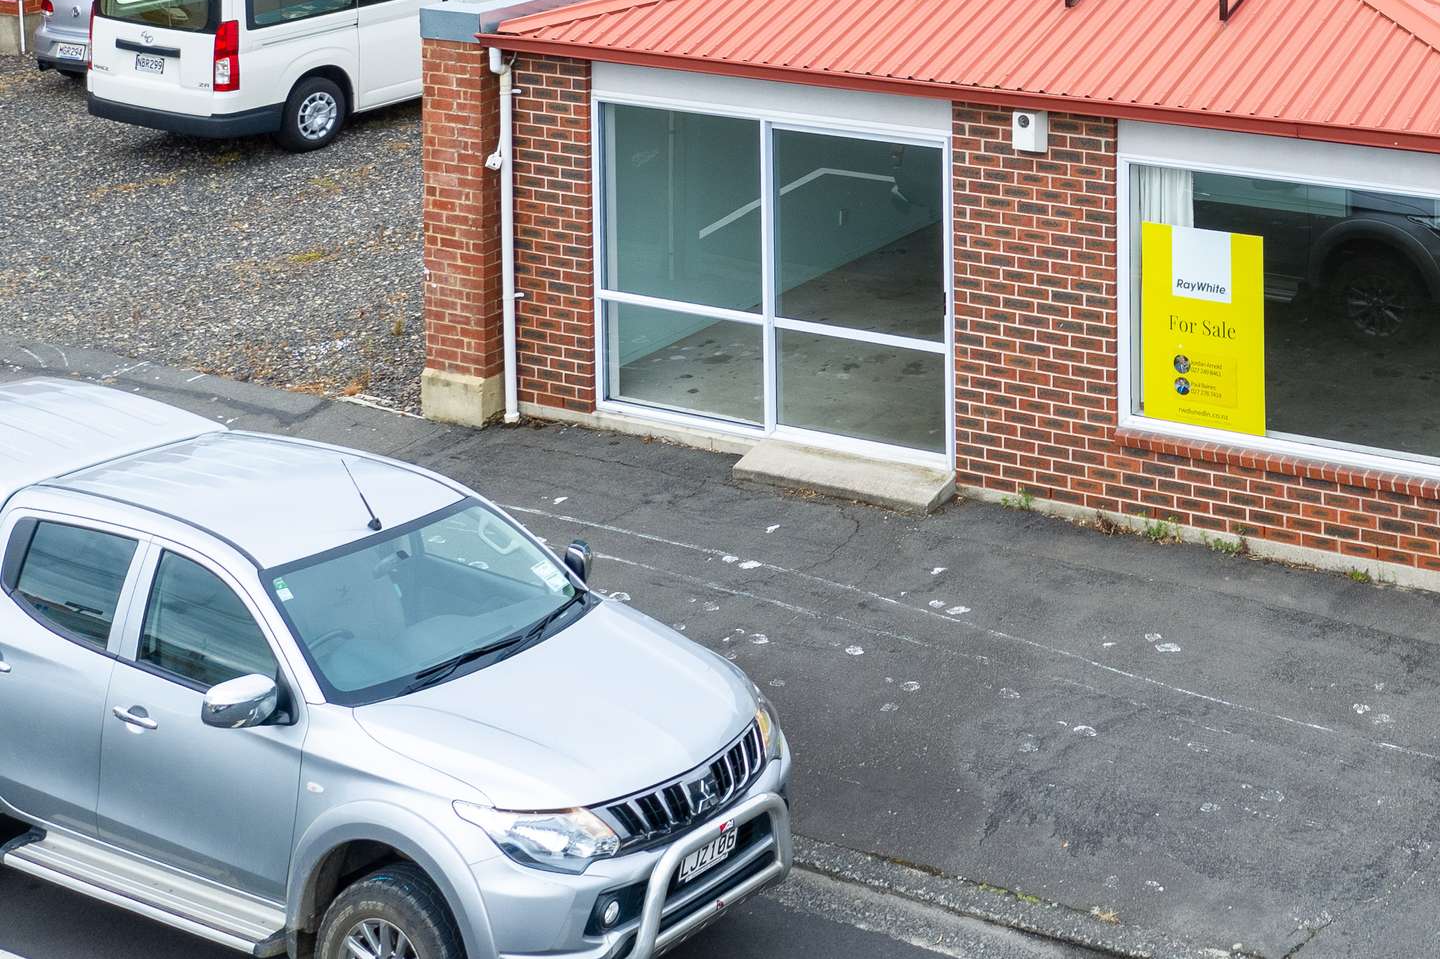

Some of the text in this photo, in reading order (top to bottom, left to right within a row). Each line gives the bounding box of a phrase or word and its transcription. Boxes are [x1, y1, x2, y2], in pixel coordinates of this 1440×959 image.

[1168, 314, 1236, 340] For Sale
[681, 829, 735, 878] LJZ106
